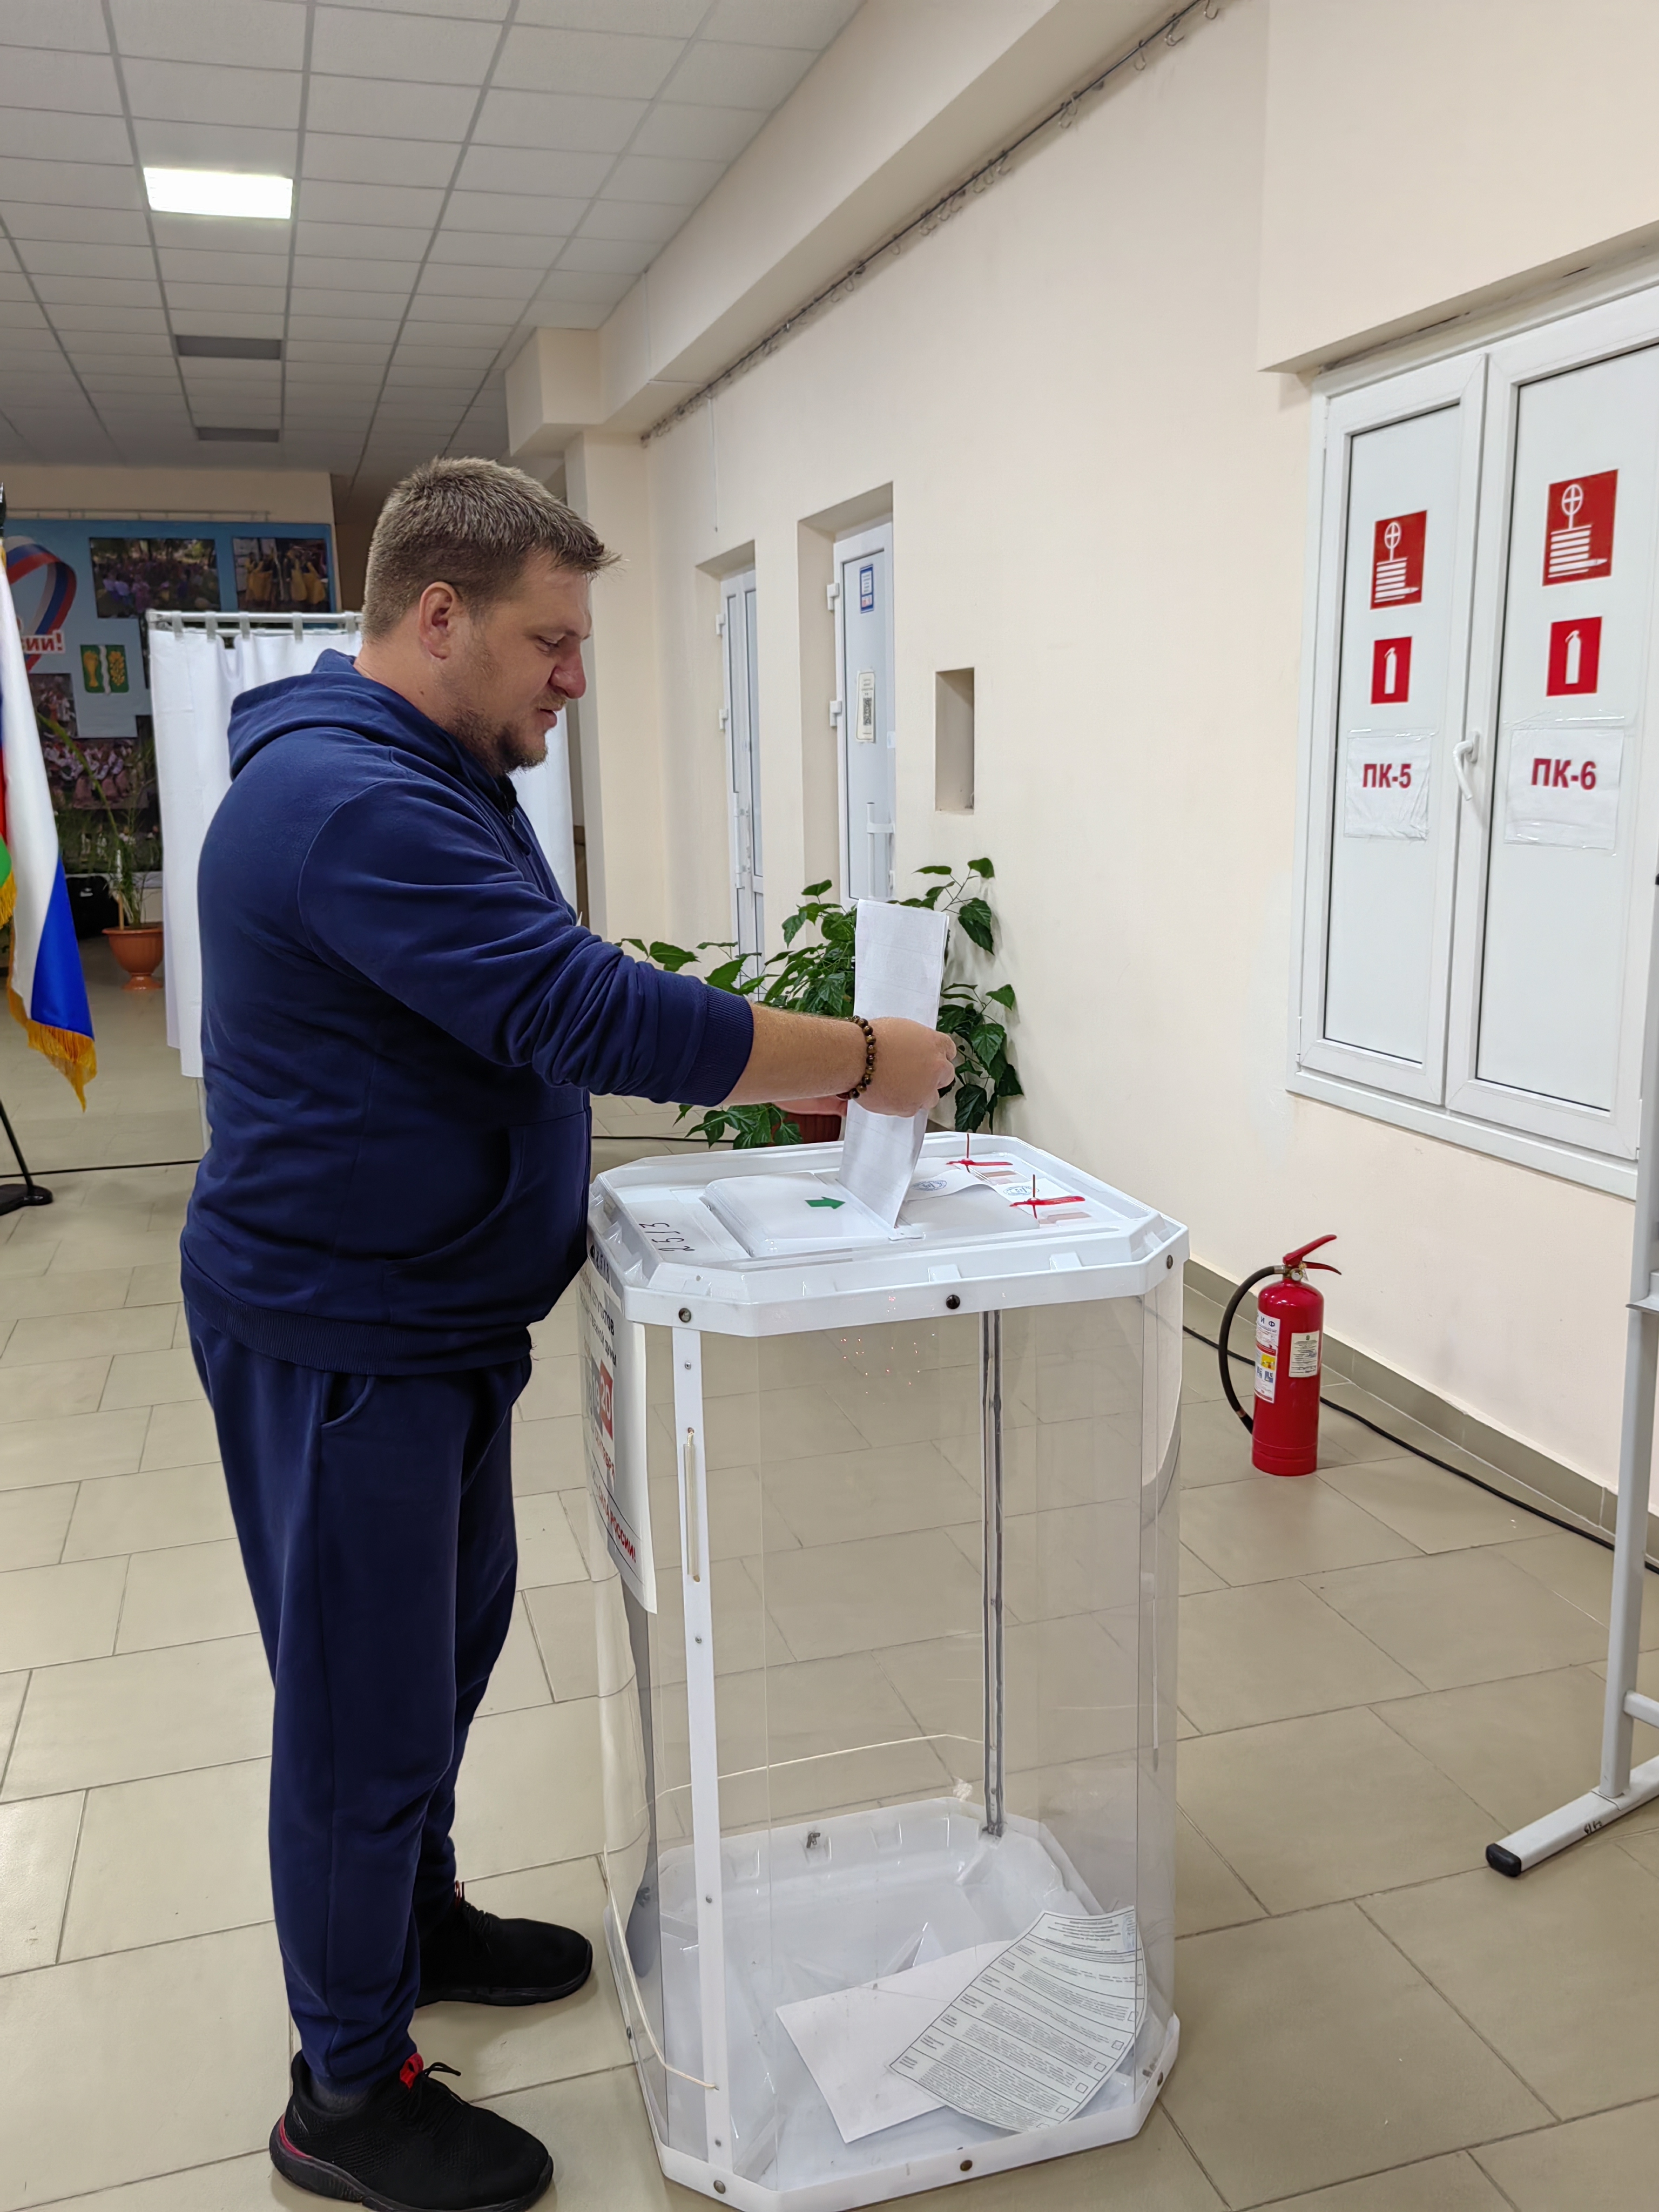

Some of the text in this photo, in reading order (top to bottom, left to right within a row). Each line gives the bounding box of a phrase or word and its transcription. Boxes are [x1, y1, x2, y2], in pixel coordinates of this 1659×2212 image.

[1363, 763, 1412, 788] ПК-5
[1531, 758, 1596, 790] ПК-6
[638, 1222, 695, 1252] 2513
